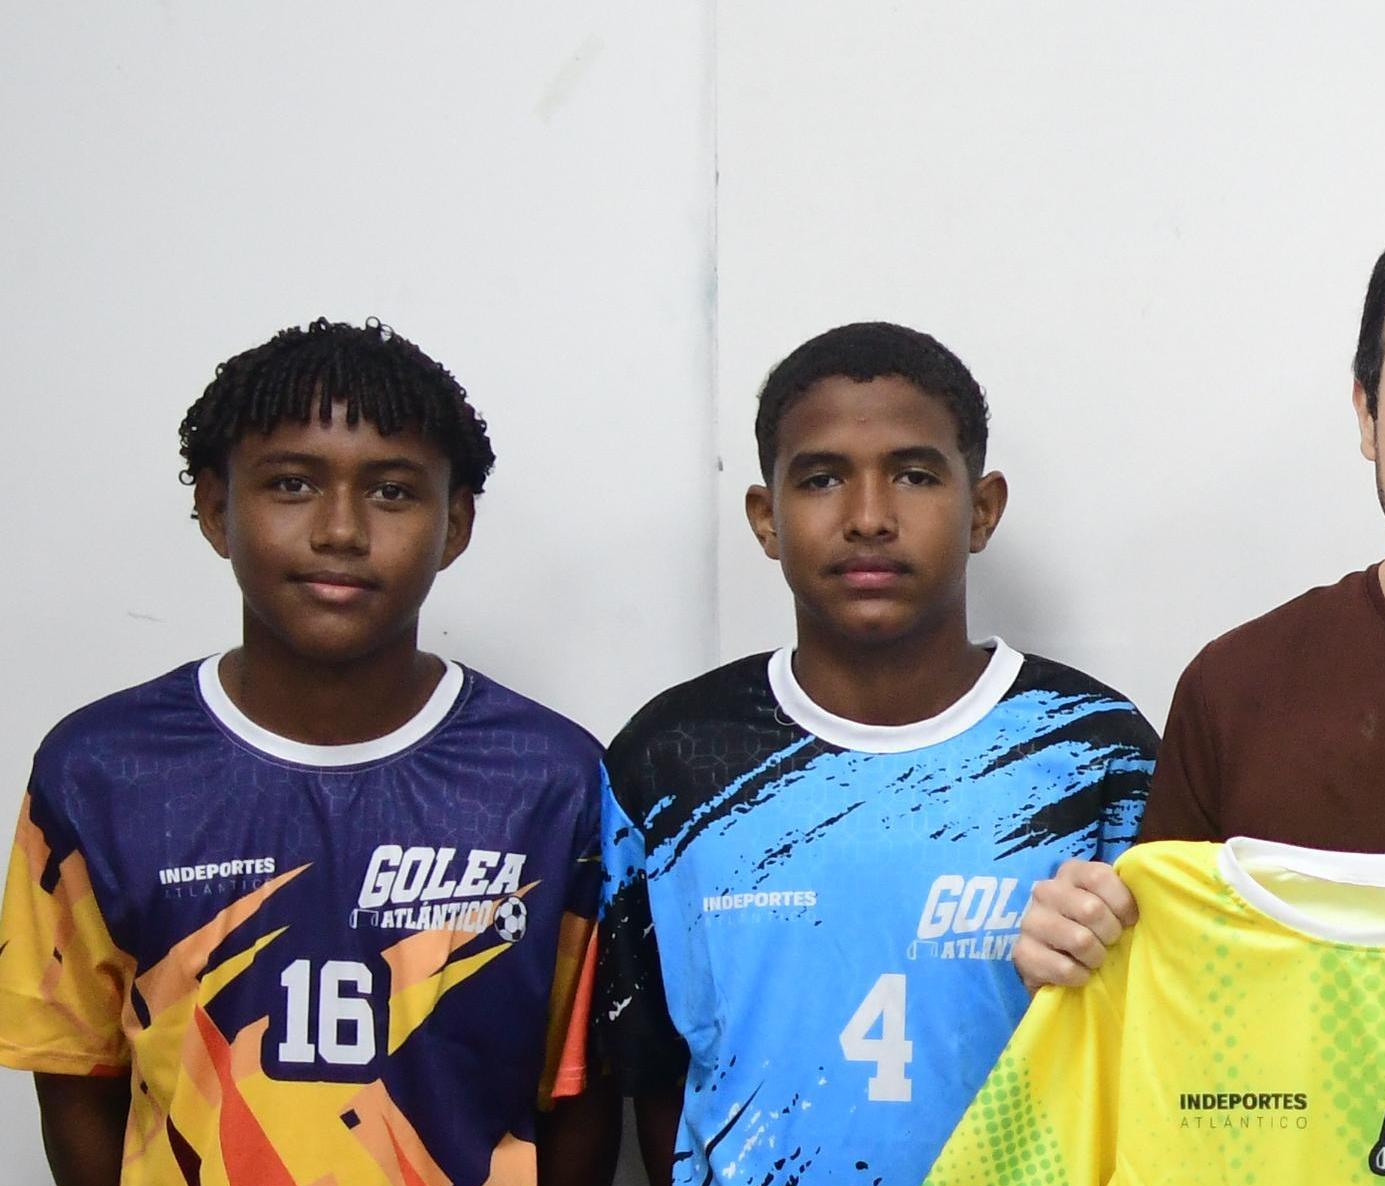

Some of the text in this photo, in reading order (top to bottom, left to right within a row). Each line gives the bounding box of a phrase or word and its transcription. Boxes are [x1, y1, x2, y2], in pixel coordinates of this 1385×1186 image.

[159, 857, 276, 885] INDEPORTES
[358, 844, 527, 909] GOLEA
[380, 901, 493, 933] ATLÁNTICO
[703, 891, 817, 912] INDEPORTES
[917, 874, 1033, 940] GOL
[278, 959, 377, 1065] 16
[839, 973, 913, 1101] 4
[1180, 1093, 1308, 1110] INDEPORTES
